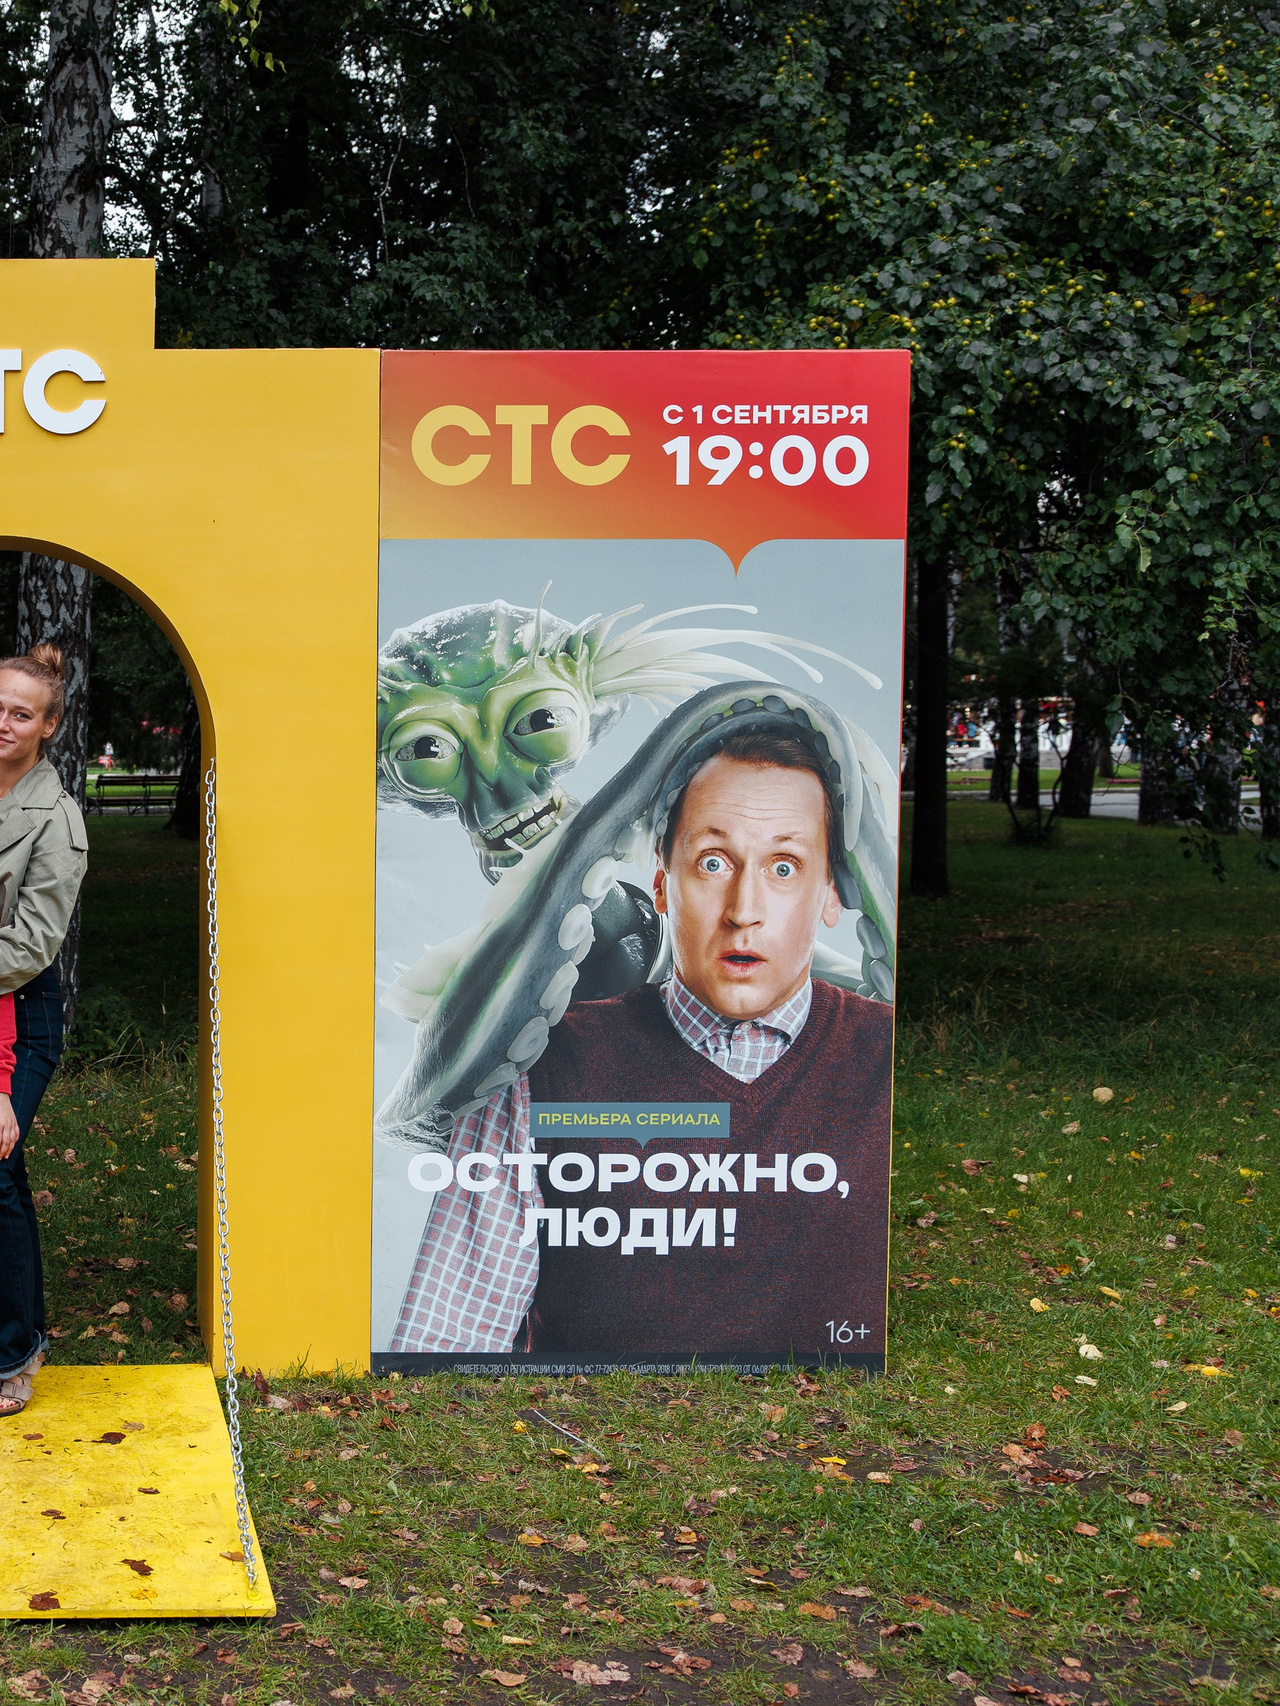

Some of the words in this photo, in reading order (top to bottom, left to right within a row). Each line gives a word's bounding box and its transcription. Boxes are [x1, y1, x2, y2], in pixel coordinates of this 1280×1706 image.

[662, 404, 684, 424] С
[691, 404, 703, 424] 1
[711, 404, 868, 424] СЕНТЯБРЯ
[411, 405, 631, 486] СТС
[662, 434, 869, 487] 19:00
[538, 1113, 632, 1126] ПРЕМЬЕРА
[636, 1112, 721, 1126] СЕРИАЛА
[407, 1152, 850, 1199] ОСТОРОЖНО,
[519, 1207, 737, 1255] ЛЮДИ!
[825, 1320, 871, 1343] 16+
[551, 1364, 566, 1374] СМИ
